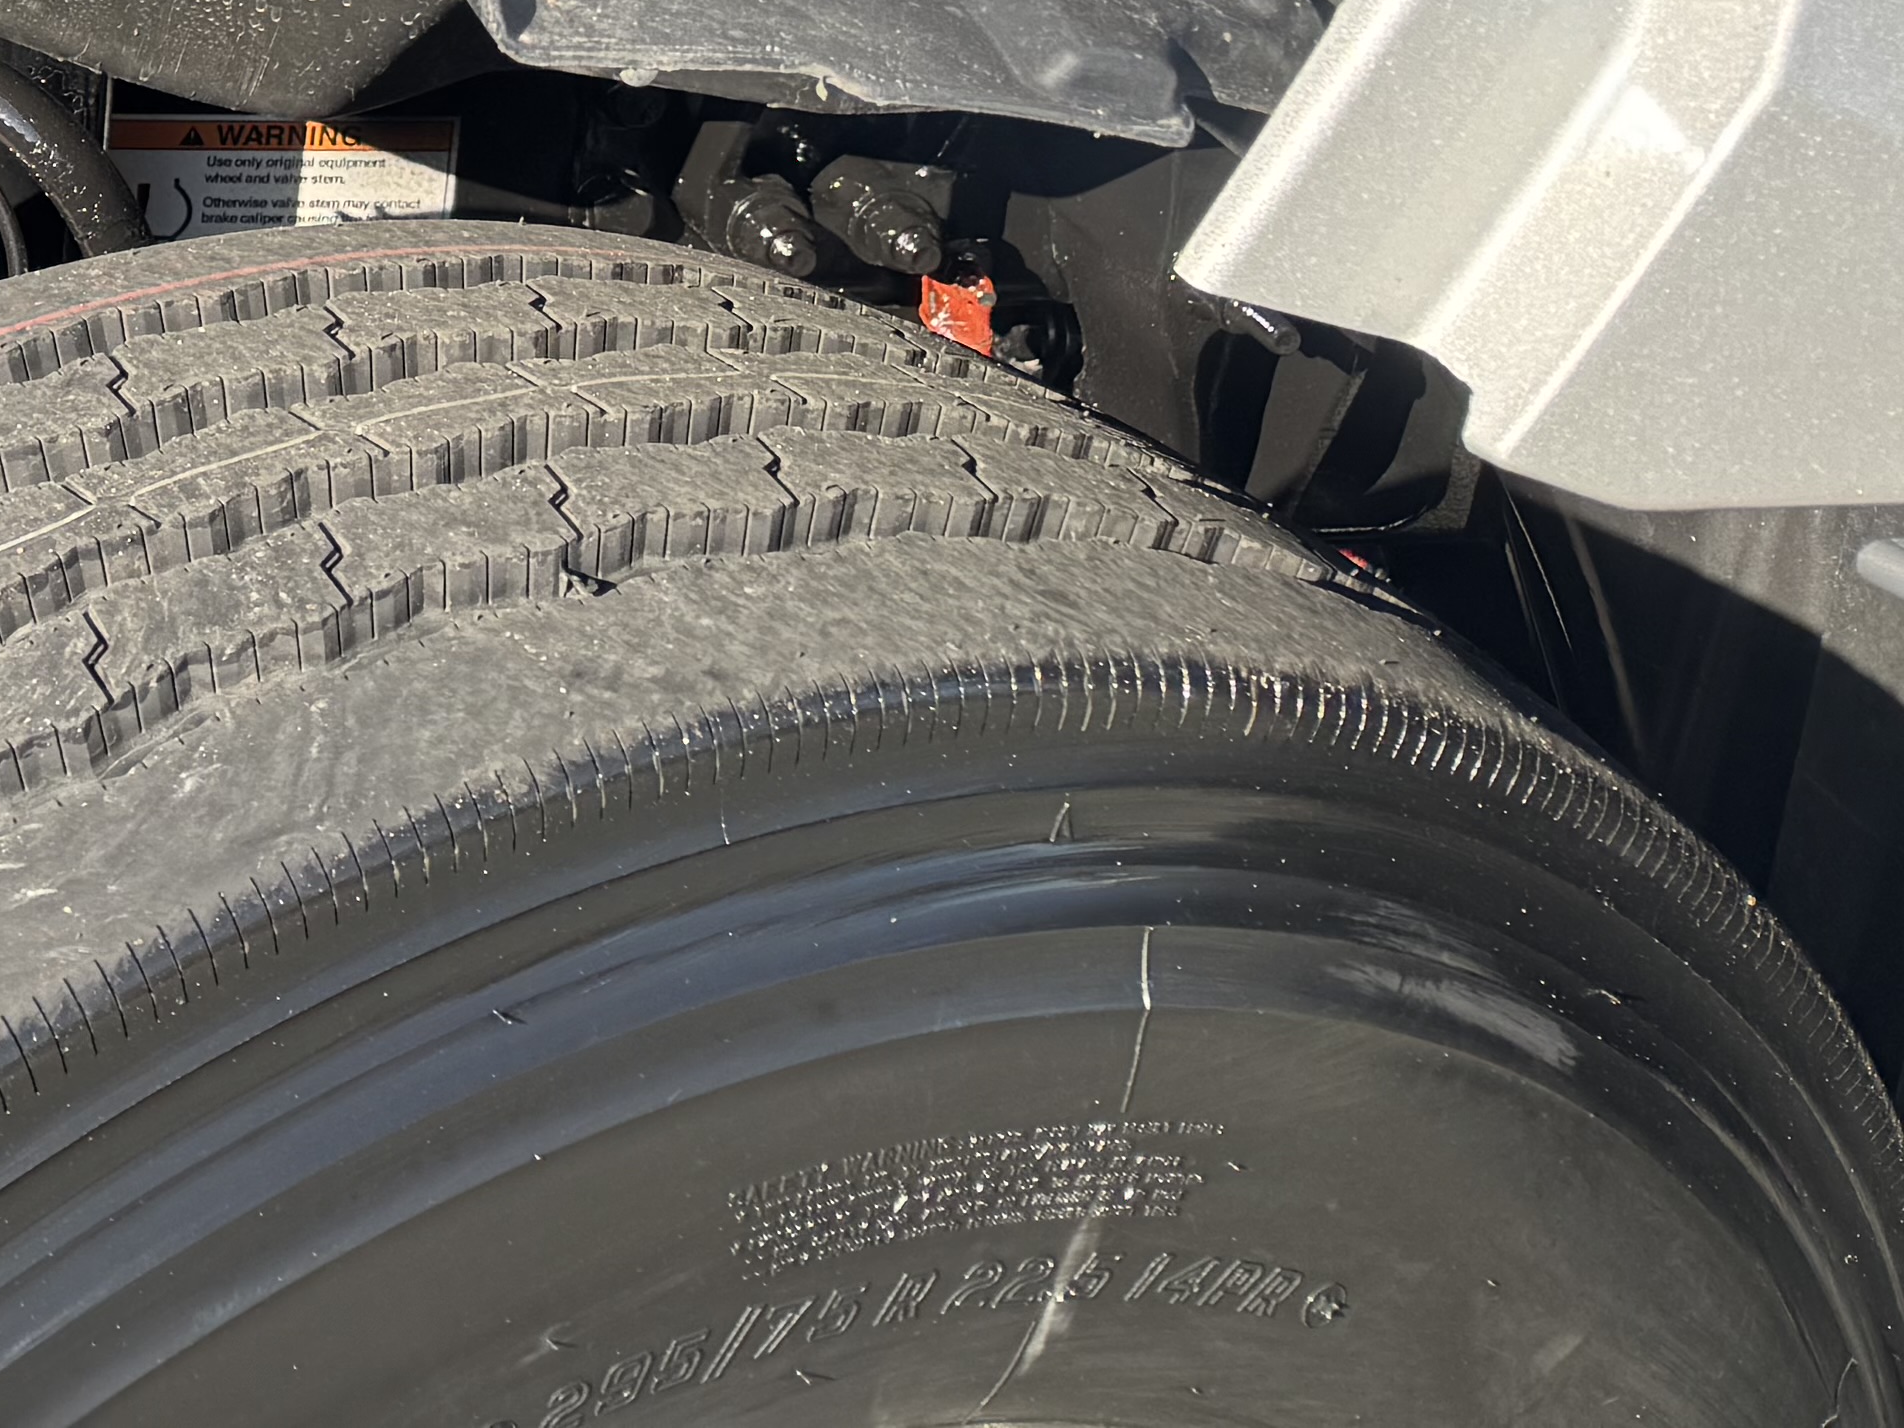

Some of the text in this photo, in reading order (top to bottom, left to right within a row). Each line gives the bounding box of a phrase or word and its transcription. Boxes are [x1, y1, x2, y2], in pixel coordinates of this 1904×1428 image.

[217, 125, 362, 146] WARNING
[207, 156, 386, 170] Use only original equipment
[204, 173, 242, 184] wheel
[245, 174, 270, 184] and
[273, 174, 308, 184] valve
[202, 197, 421, 211] Otherwise valve stem may contact
[201, 212, 238, 223] brake
[240, 213, 283, 225] caliper
[540, 1253, 1307, 1428] 295/75 R 22.5 14PR
